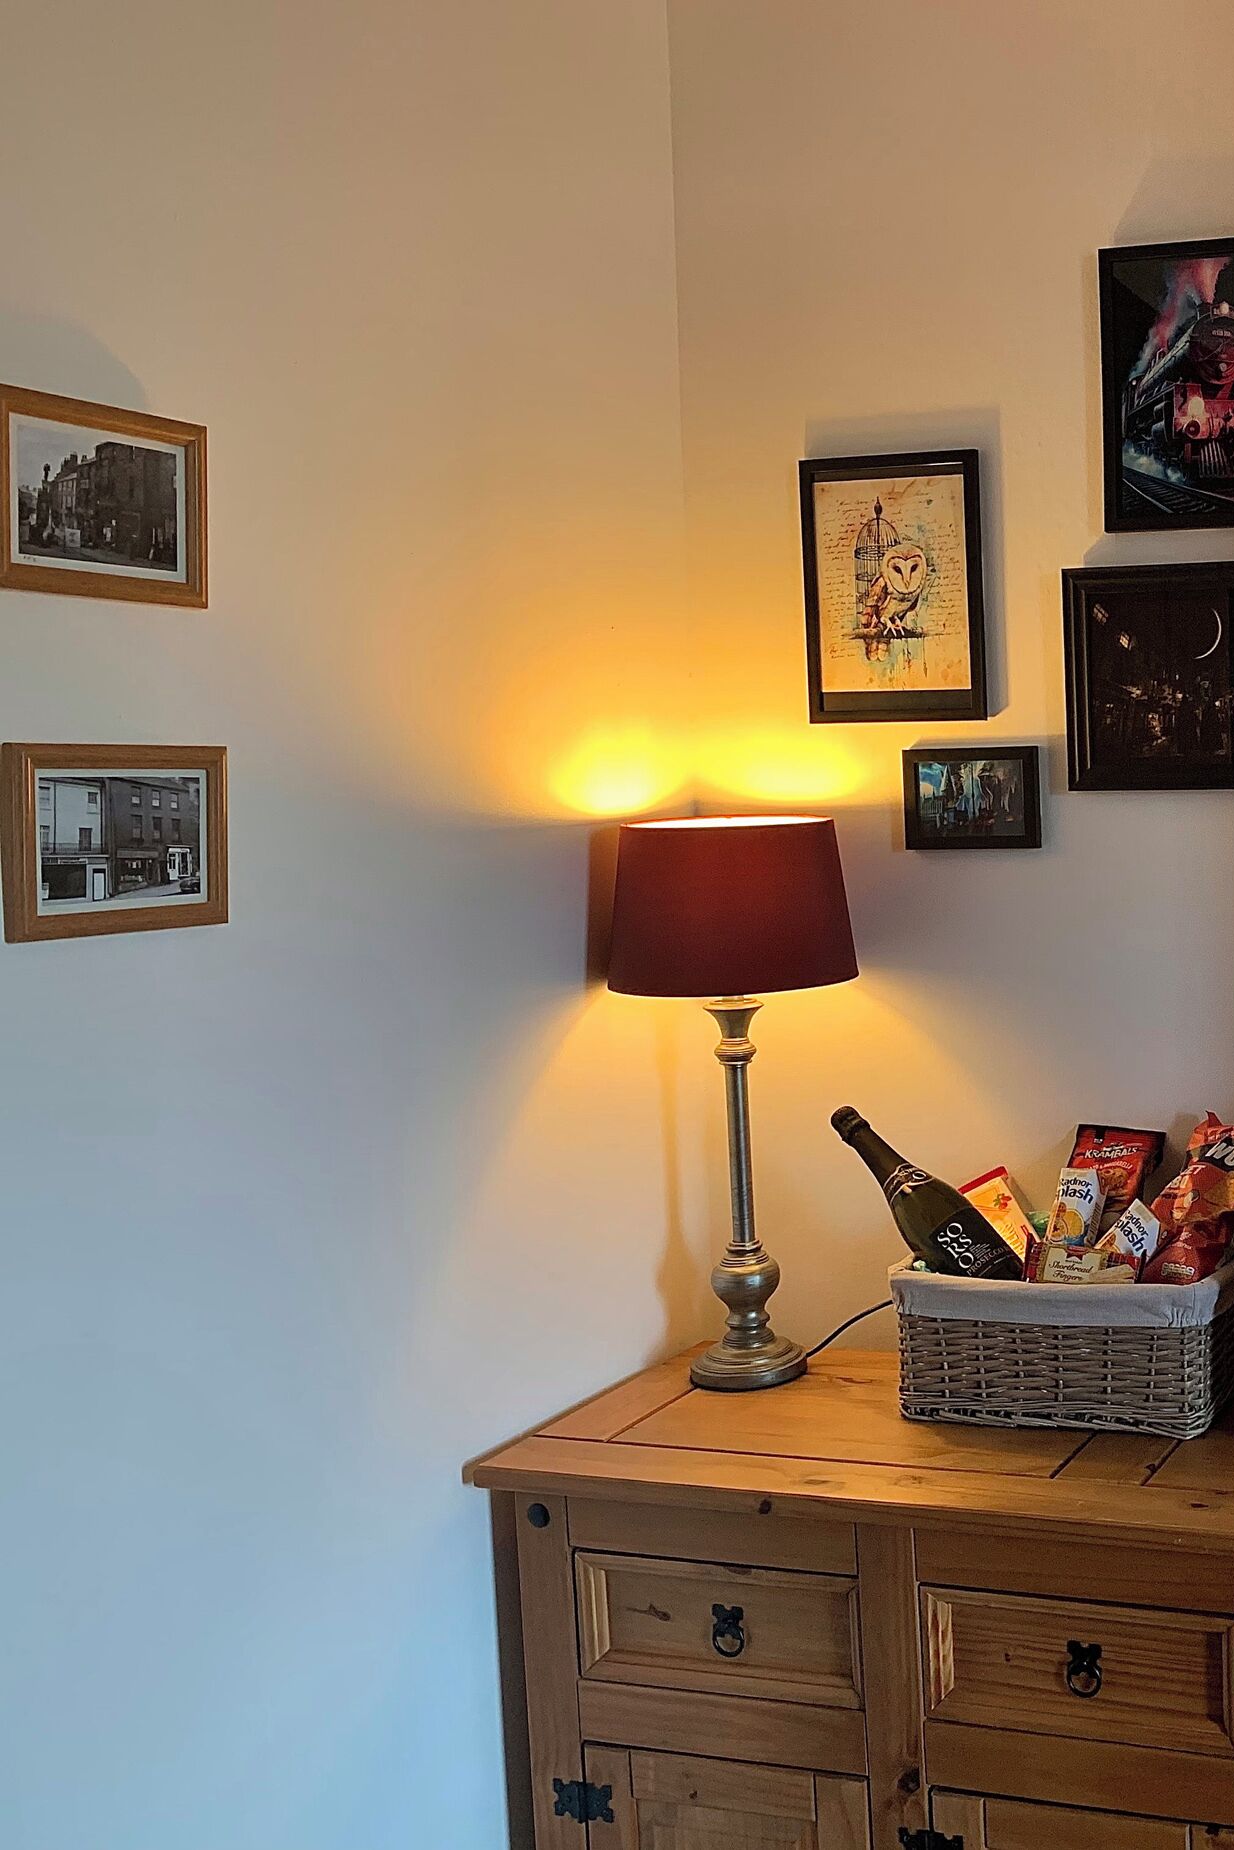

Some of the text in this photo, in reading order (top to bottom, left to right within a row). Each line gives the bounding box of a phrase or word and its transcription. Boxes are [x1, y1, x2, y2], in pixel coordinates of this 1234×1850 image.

[1084, 1146, 1138, 1160] KRAMBALS
[1057, 1185, 1094, 1205] plash
[1114, 1218, 1145, 1252] plash
[966, 1247, 1006, 1276] PROSECCO
[1048, 1259, 1093, 1273] Shortbread
